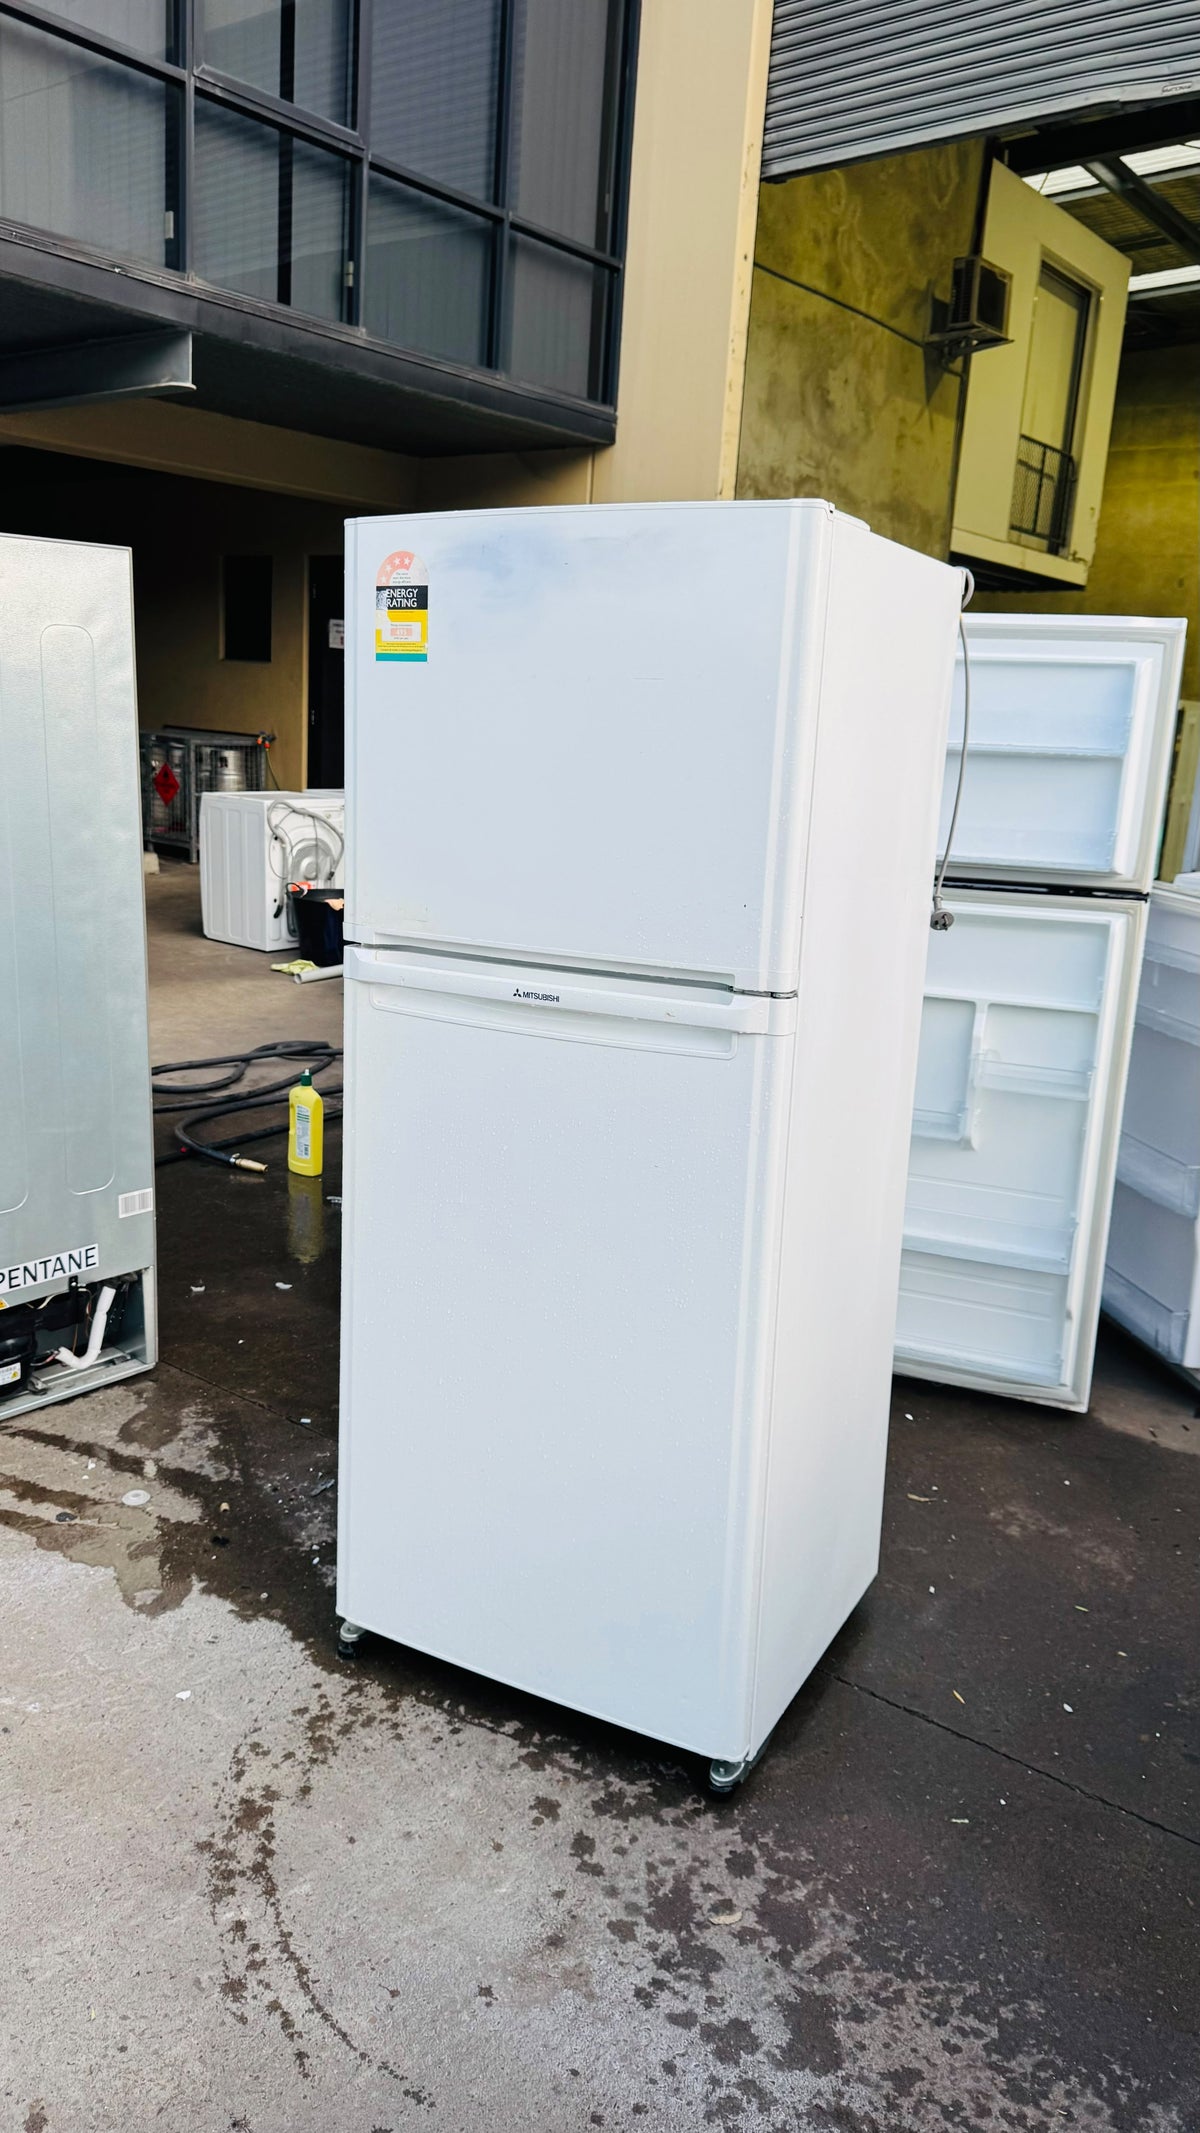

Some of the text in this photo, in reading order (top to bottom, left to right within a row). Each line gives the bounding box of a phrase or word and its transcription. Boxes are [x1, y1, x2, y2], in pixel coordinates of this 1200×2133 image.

[386, 588, 418, 598] ENERGY
[386, 598, 417, 608] RATING
[522, 991, 560, 1003] MITSUBISHI
